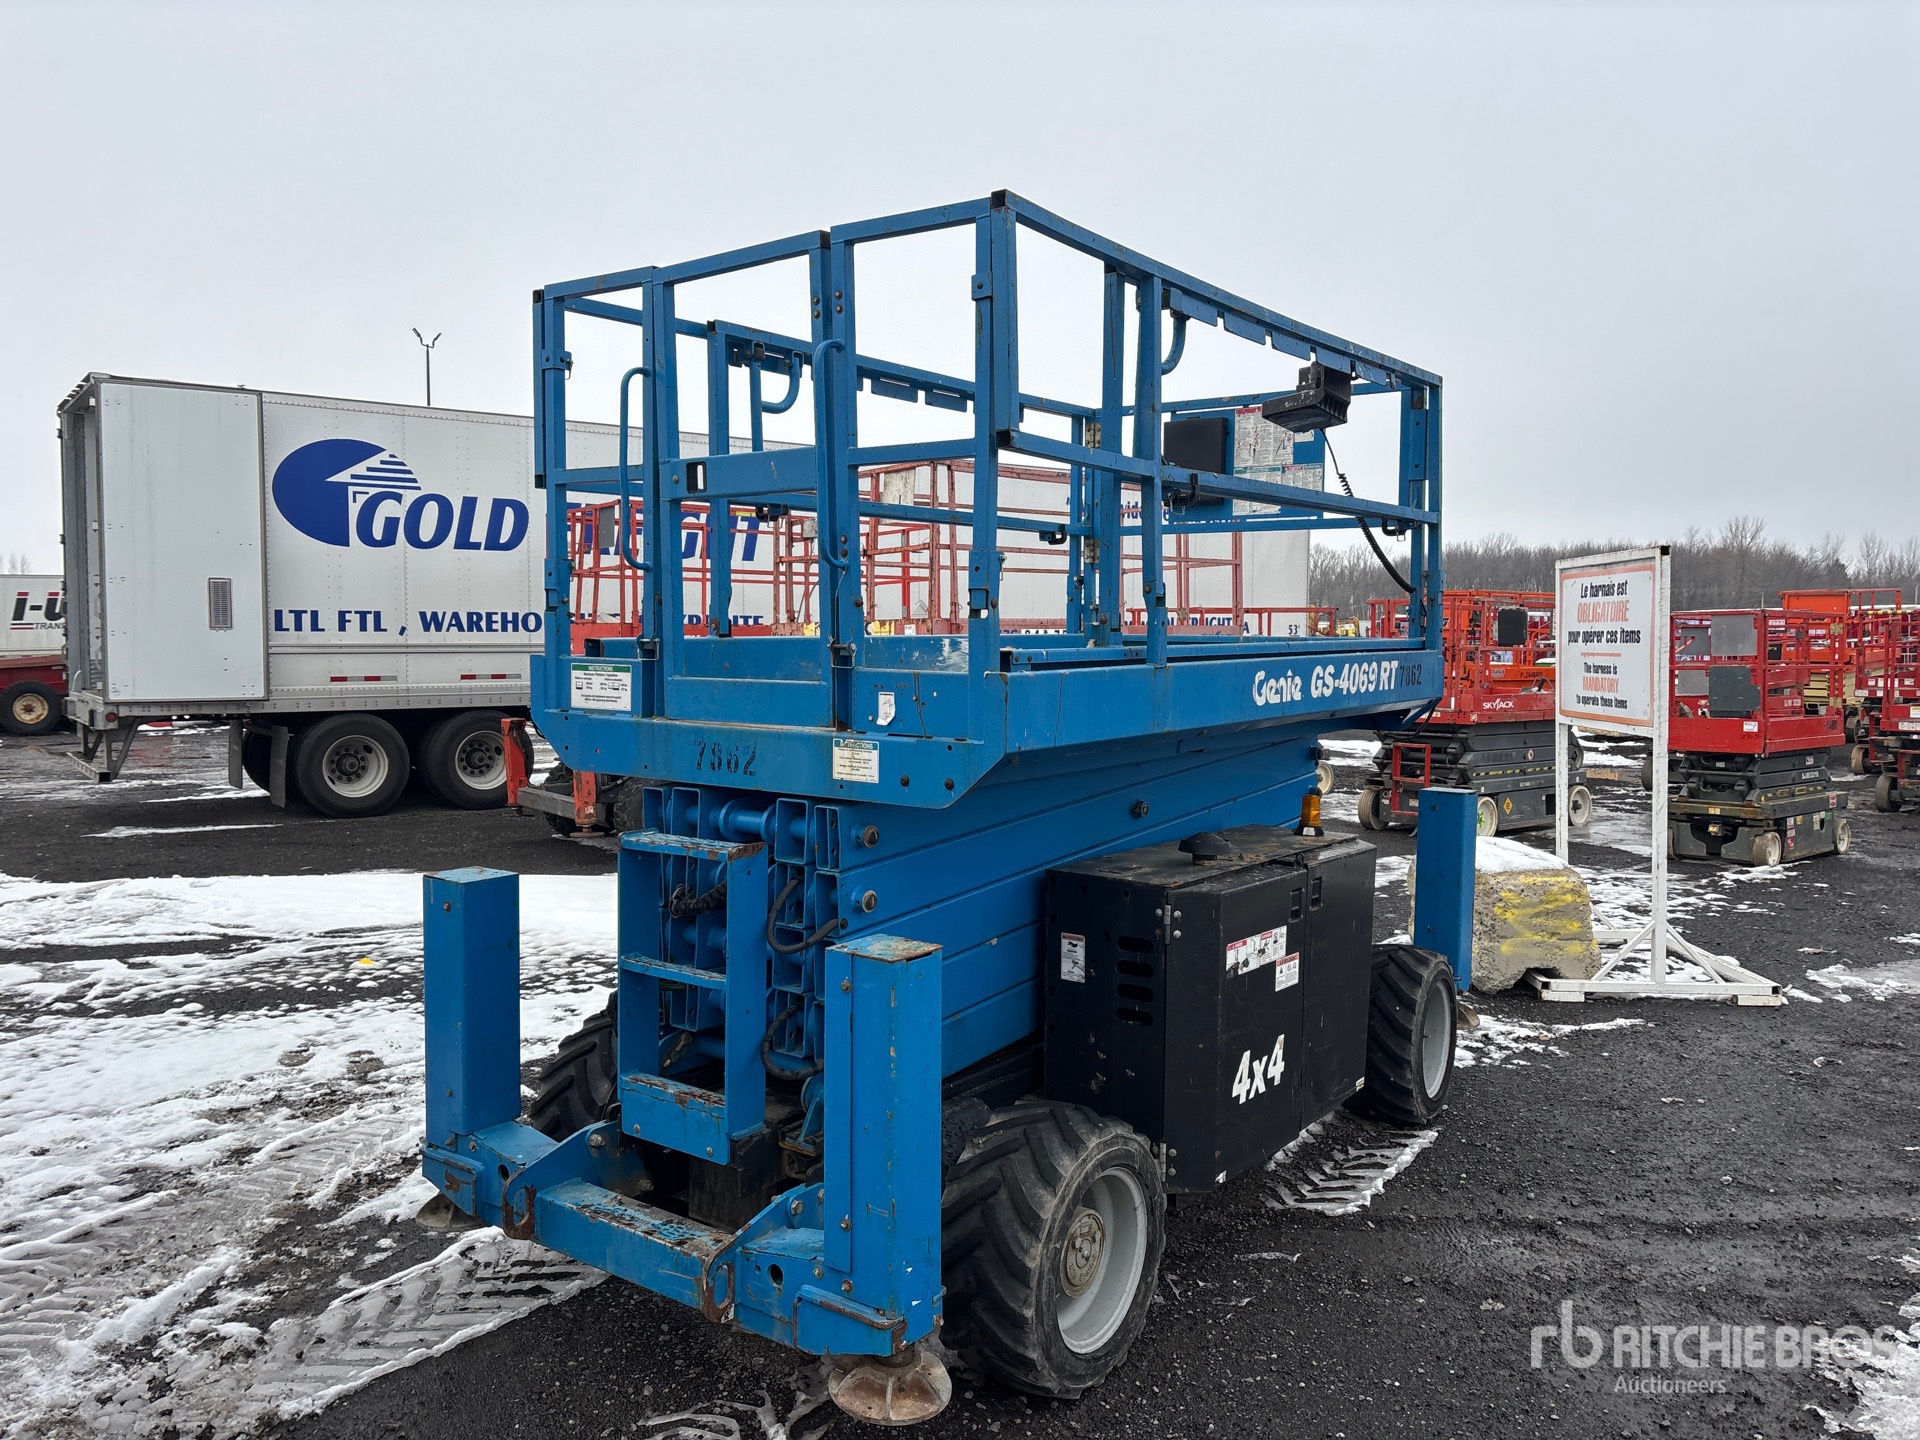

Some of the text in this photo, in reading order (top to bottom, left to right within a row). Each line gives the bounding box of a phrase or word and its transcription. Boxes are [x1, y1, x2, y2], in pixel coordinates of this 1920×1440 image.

[355, 491, 529, 551] GOLD
[1580, 580, 1628, 598] Le harnais est
[274, 609, 325, 632] LTL
[338, 610, 388, 632] FTL
[1577, 600, 1630, 623] OBLIGATOIRE
[1568, 626, 1641, 645] pour opérer ces items
[1583, 662, 1618, 675] The harness is
[1253, 669, 1302, 706] Genie
[1400, 664, 1422, 687] 7862
[1583, 676, 1619, 693] MANDATORY
[1482, 698, 1514, 710] SKYJACK
[1576, 694, 1628, 710] to operate these items
[694, 741, 756, 775] 7862
[1231, 1033, 1285, 1105] 4x4
